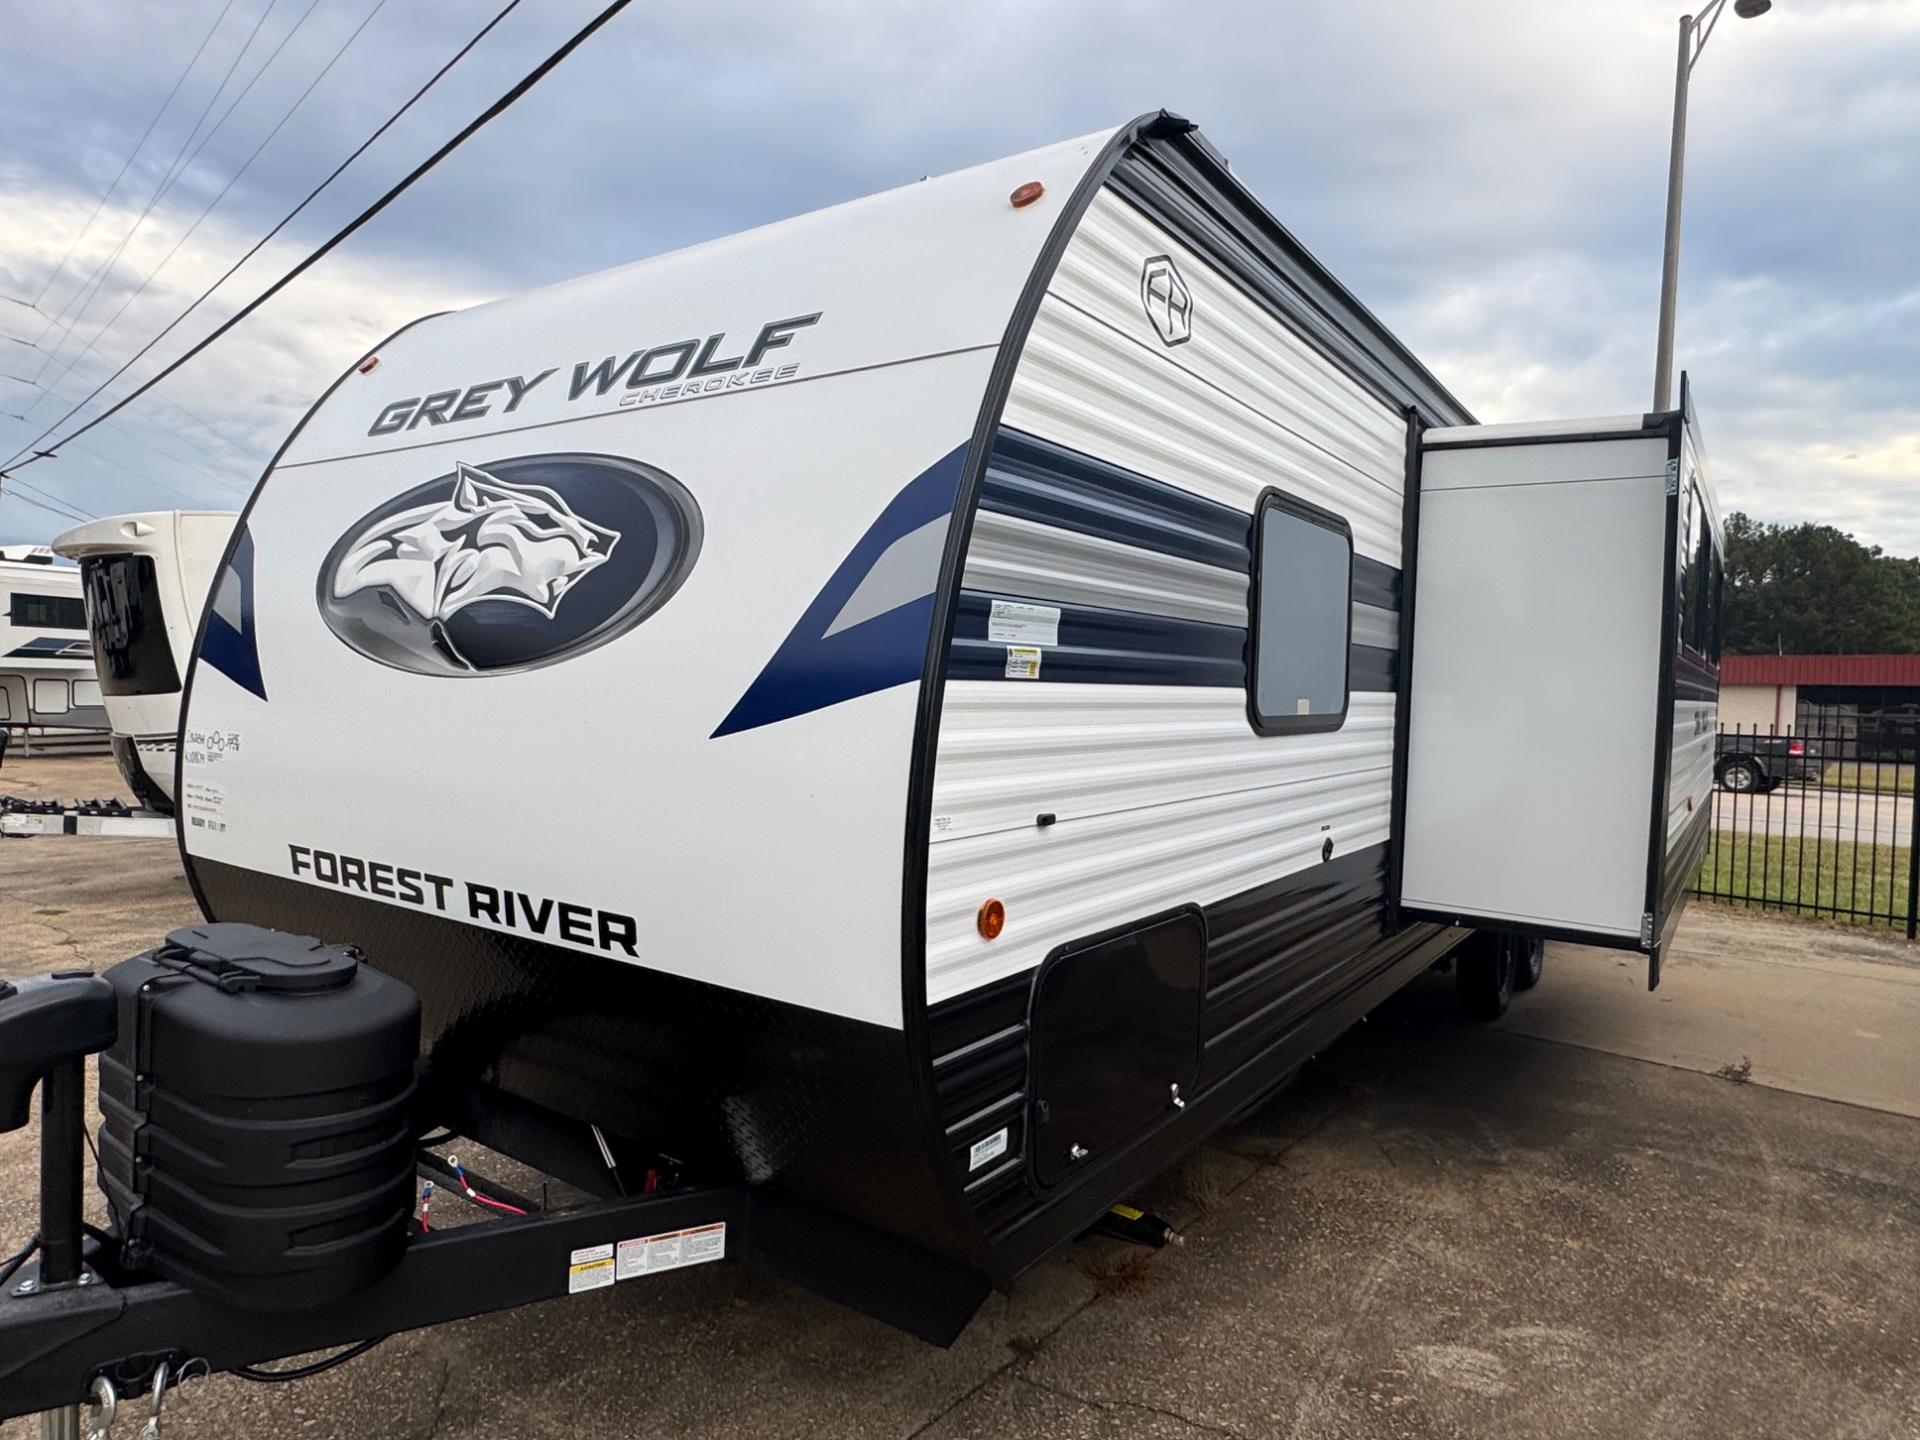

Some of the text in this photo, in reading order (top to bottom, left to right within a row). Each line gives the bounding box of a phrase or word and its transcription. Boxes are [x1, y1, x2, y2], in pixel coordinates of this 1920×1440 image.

[367, 311, 823, 437] GREY WOLF
[619, 363, 800, 406] CHEROKEE
[288, 844, 640, 958] FOREST RIVER
